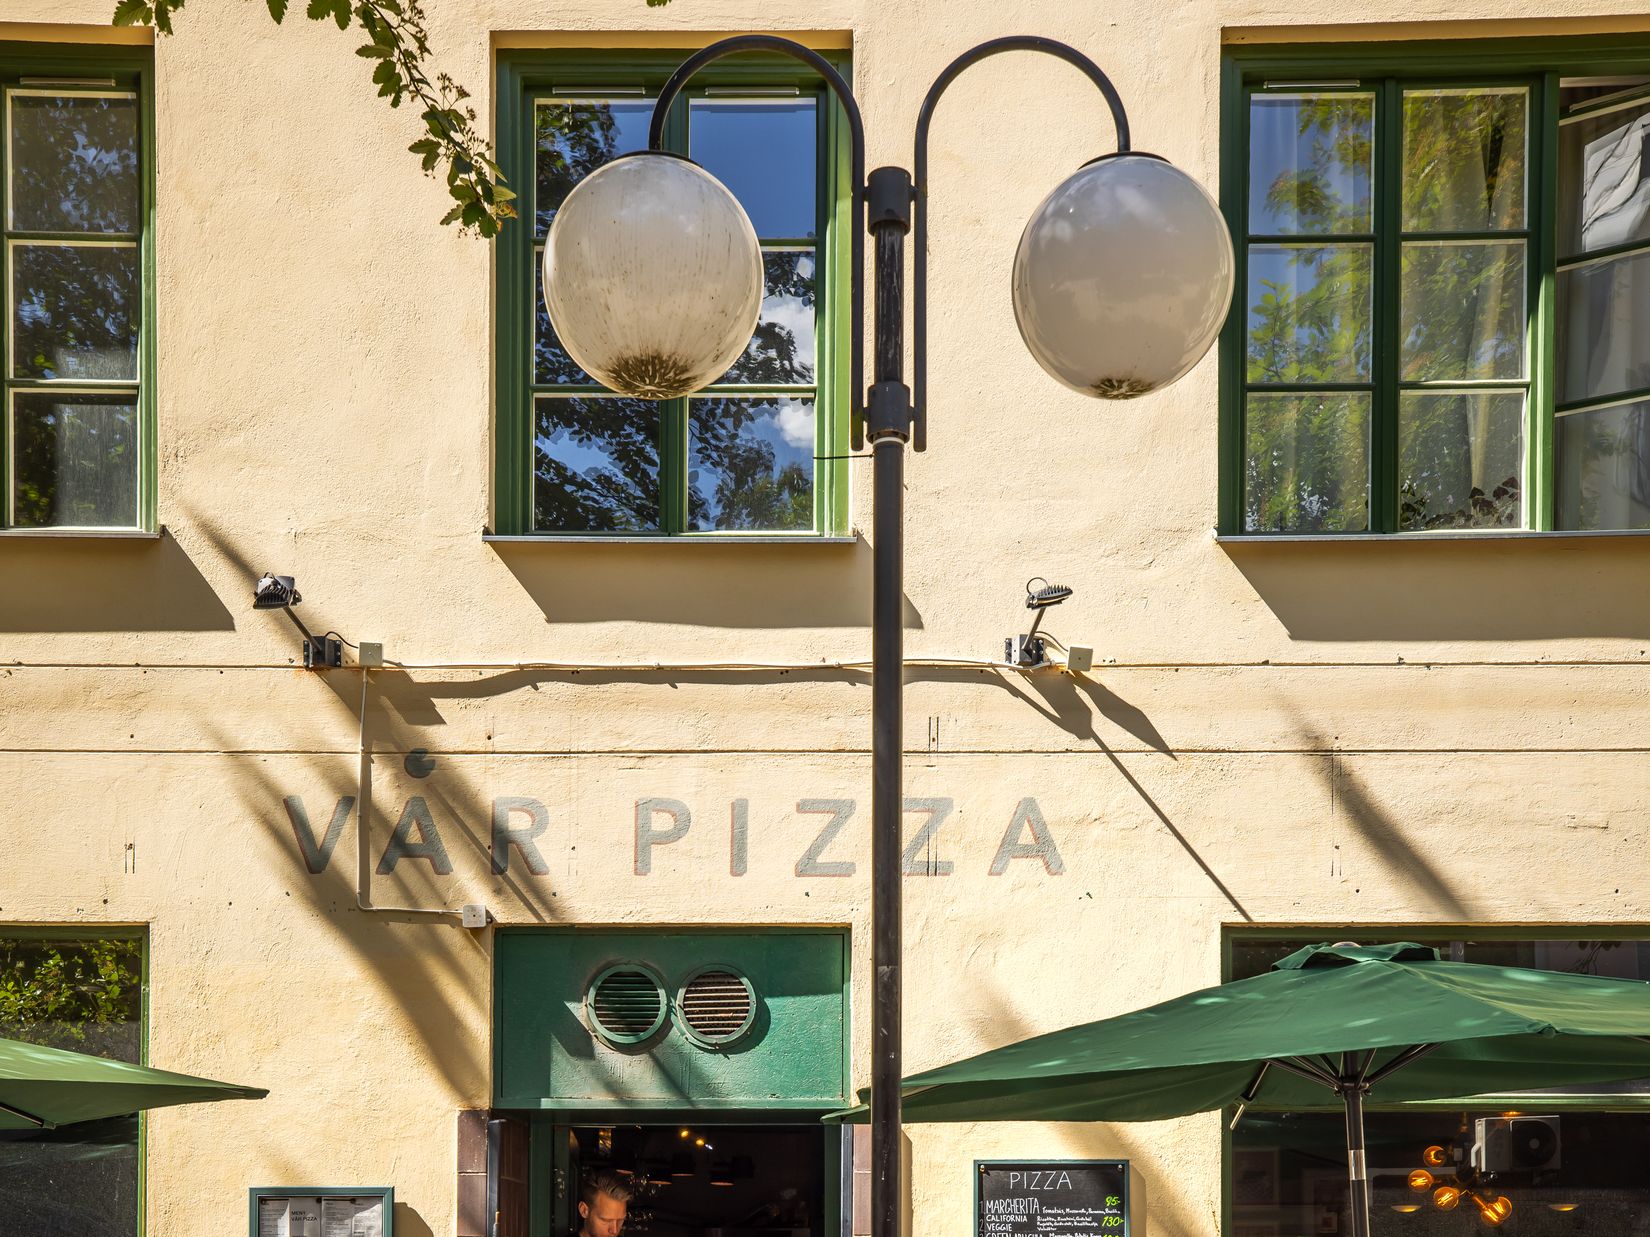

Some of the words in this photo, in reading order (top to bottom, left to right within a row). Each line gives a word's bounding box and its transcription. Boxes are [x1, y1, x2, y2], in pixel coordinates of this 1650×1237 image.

[283, 748, 550, 876] VÅR
[634, 797, 1066, 876] PIZZA
[1009, 1171, 1072, 1190] PIZZA
[985, 1198, 1040, 1214] MARGHERITA
[986, 1223, 1012, 1231] VEGGIE
